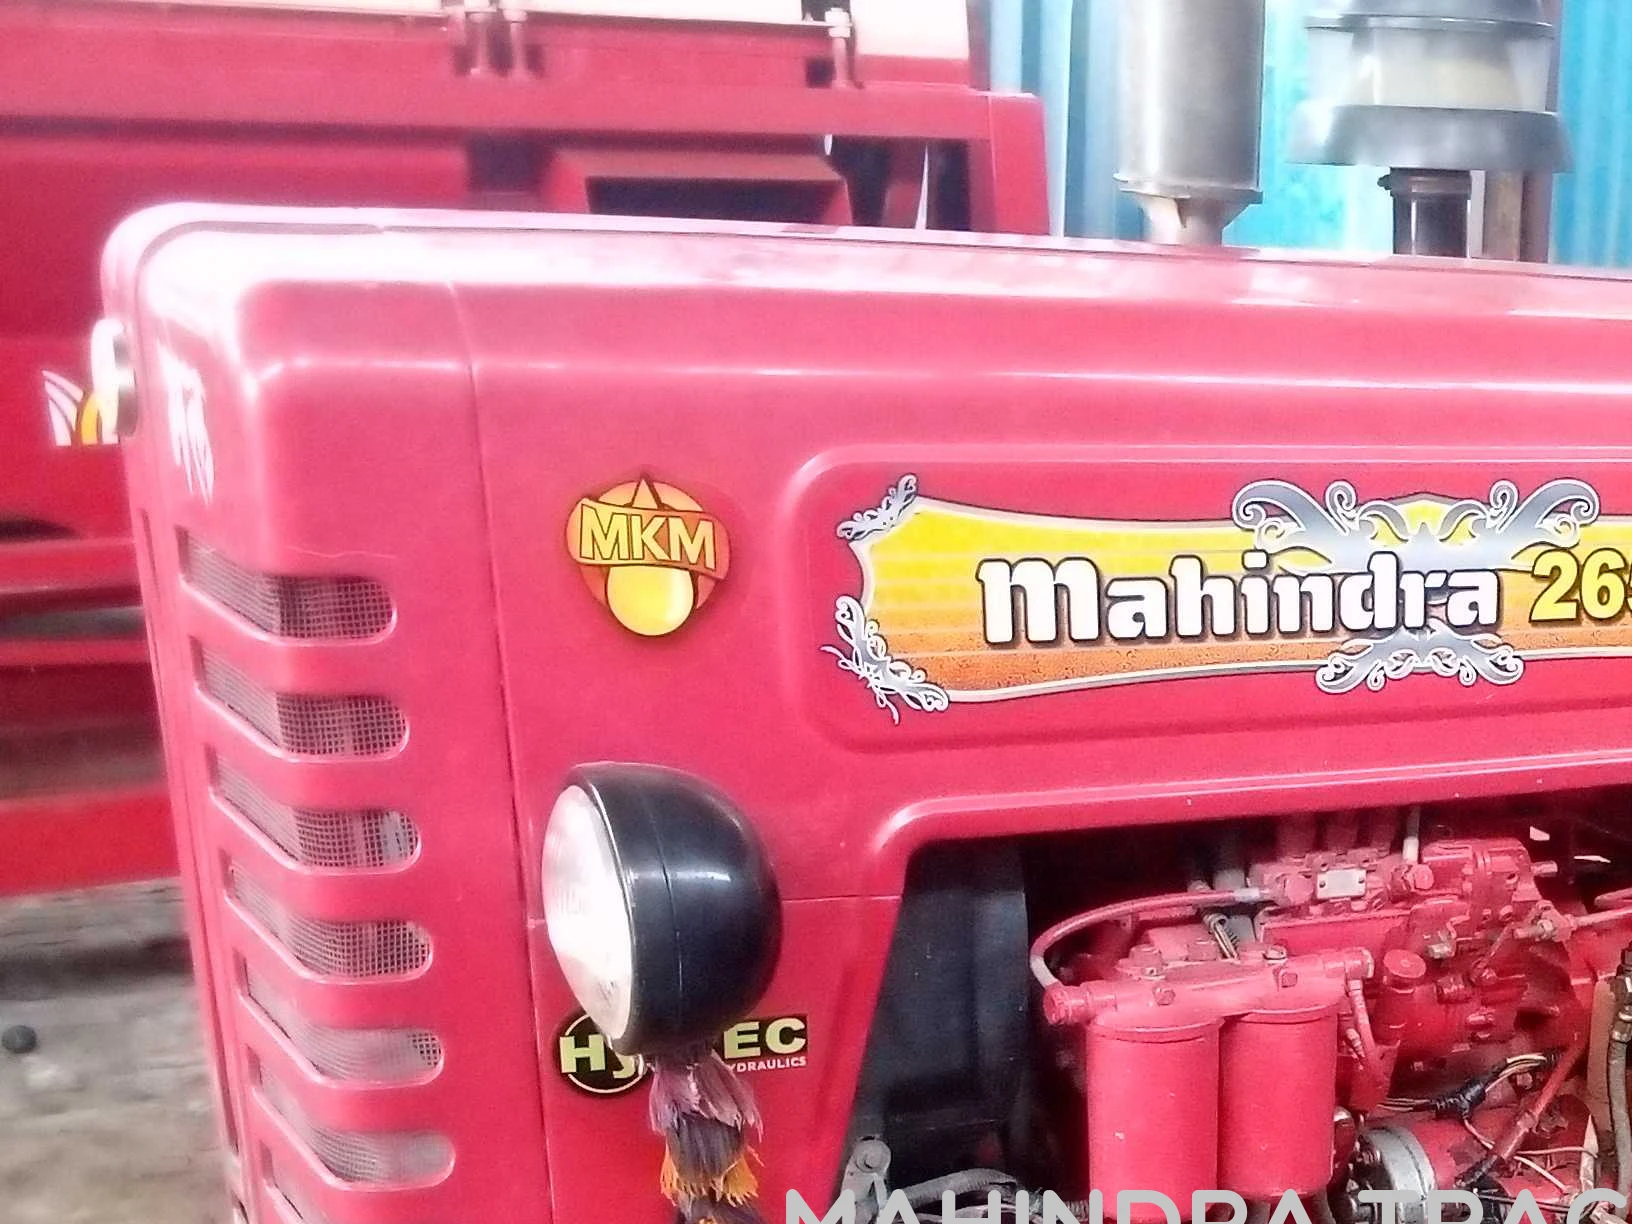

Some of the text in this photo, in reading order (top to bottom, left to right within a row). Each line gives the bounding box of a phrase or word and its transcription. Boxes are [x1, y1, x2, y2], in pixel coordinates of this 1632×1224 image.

[578, 504, 718, 573] MKM
[977, 549, 1499, 645] Mahindra
[726, 1055, 807, 1074] YDRAULICS
